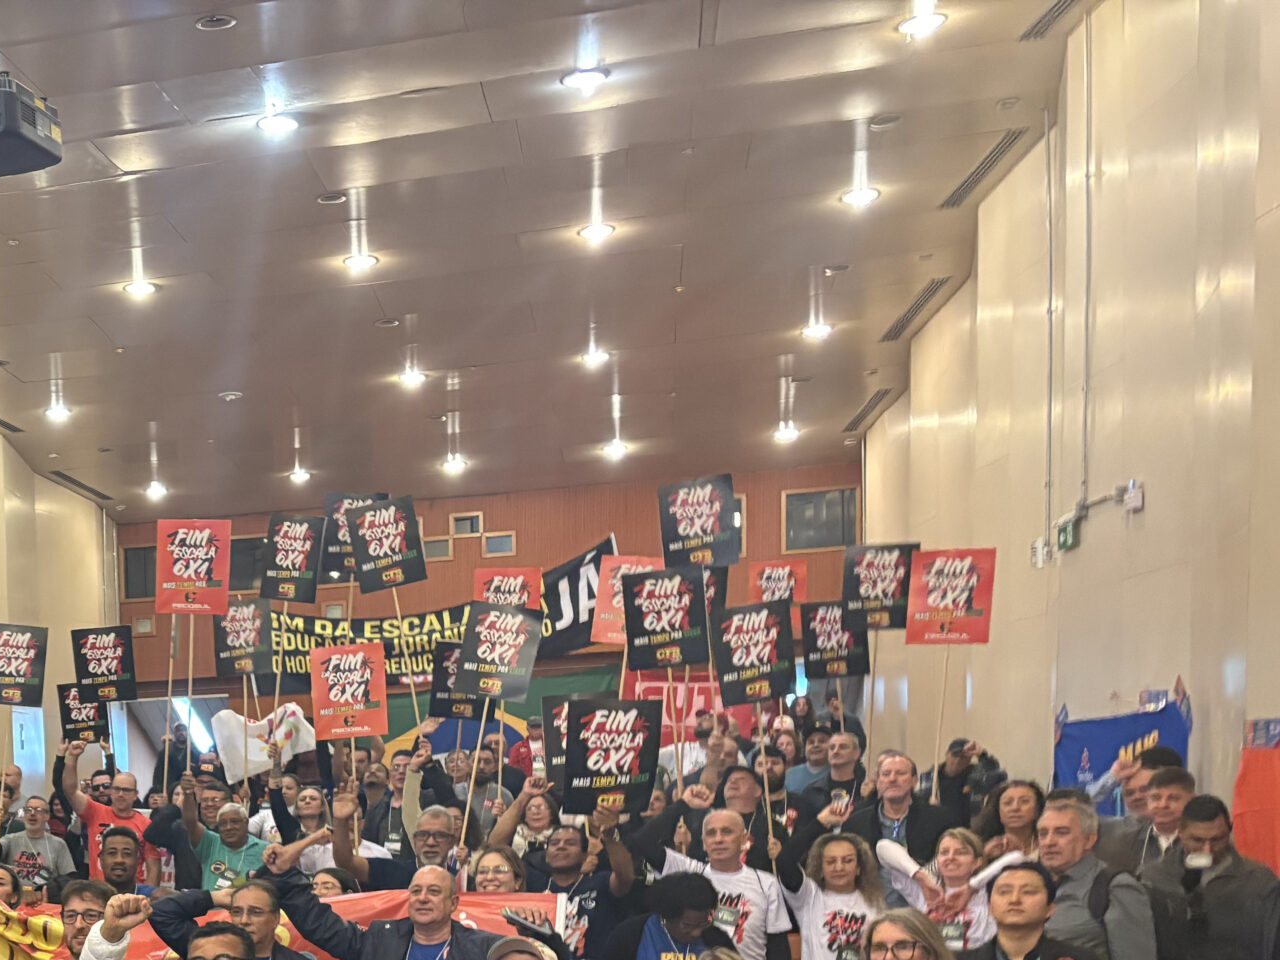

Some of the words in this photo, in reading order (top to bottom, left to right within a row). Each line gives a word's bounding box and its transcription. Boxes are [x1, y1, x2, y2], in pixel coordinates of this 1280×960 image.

[364, 505, 396, 528] FIM
[175, 528, 212, 546] FIM
[280, 522, 309, 539] FIM
[173, 547, 216, 560] ESCALA
[368, 534, 401, 557] 6X1
[276, 551, 305, 569] 6X1
[173, 559, 210, 580] 6X1
[490, 575, 524, 592] FIM
[555, 550, 601, 632] JÁ
[643, 574, 681, 597] FIM
[315, 619, 354, 638] DA
[484, 610, 523, 631] FIM
[643, 609, 684, 632] 6X1
[731, 608, 768, 634] FIM
[0, 631, 32, 648] FIM
[87, 633, 116, 648] FIM
[227, 630, 255, 647] 6X1
[86, 648, 122, 660] ESCALA
[328, 652, 364, 671] FIM
[477, 642, 515, 664] 6X1
[732, 643, 771, 666] 6X1
[88, 659, 118, 675] 6X1
[478, 664, 496, 673] TEMPO
[328, 668, 371, 685] ESCALA
[329, 683, 365, 704] 6X1
[71, 707, 95, 721] 6X1
[591, 708, 638, 732] FIM
[588, 732, 643, 749] ESCALA
[587, 748, 635, 775] 6X1
[572, 777, 590, 788] MAIS
[592, 775, 616, 788] TEMPO
[616, 774, 630, 784] PRA
